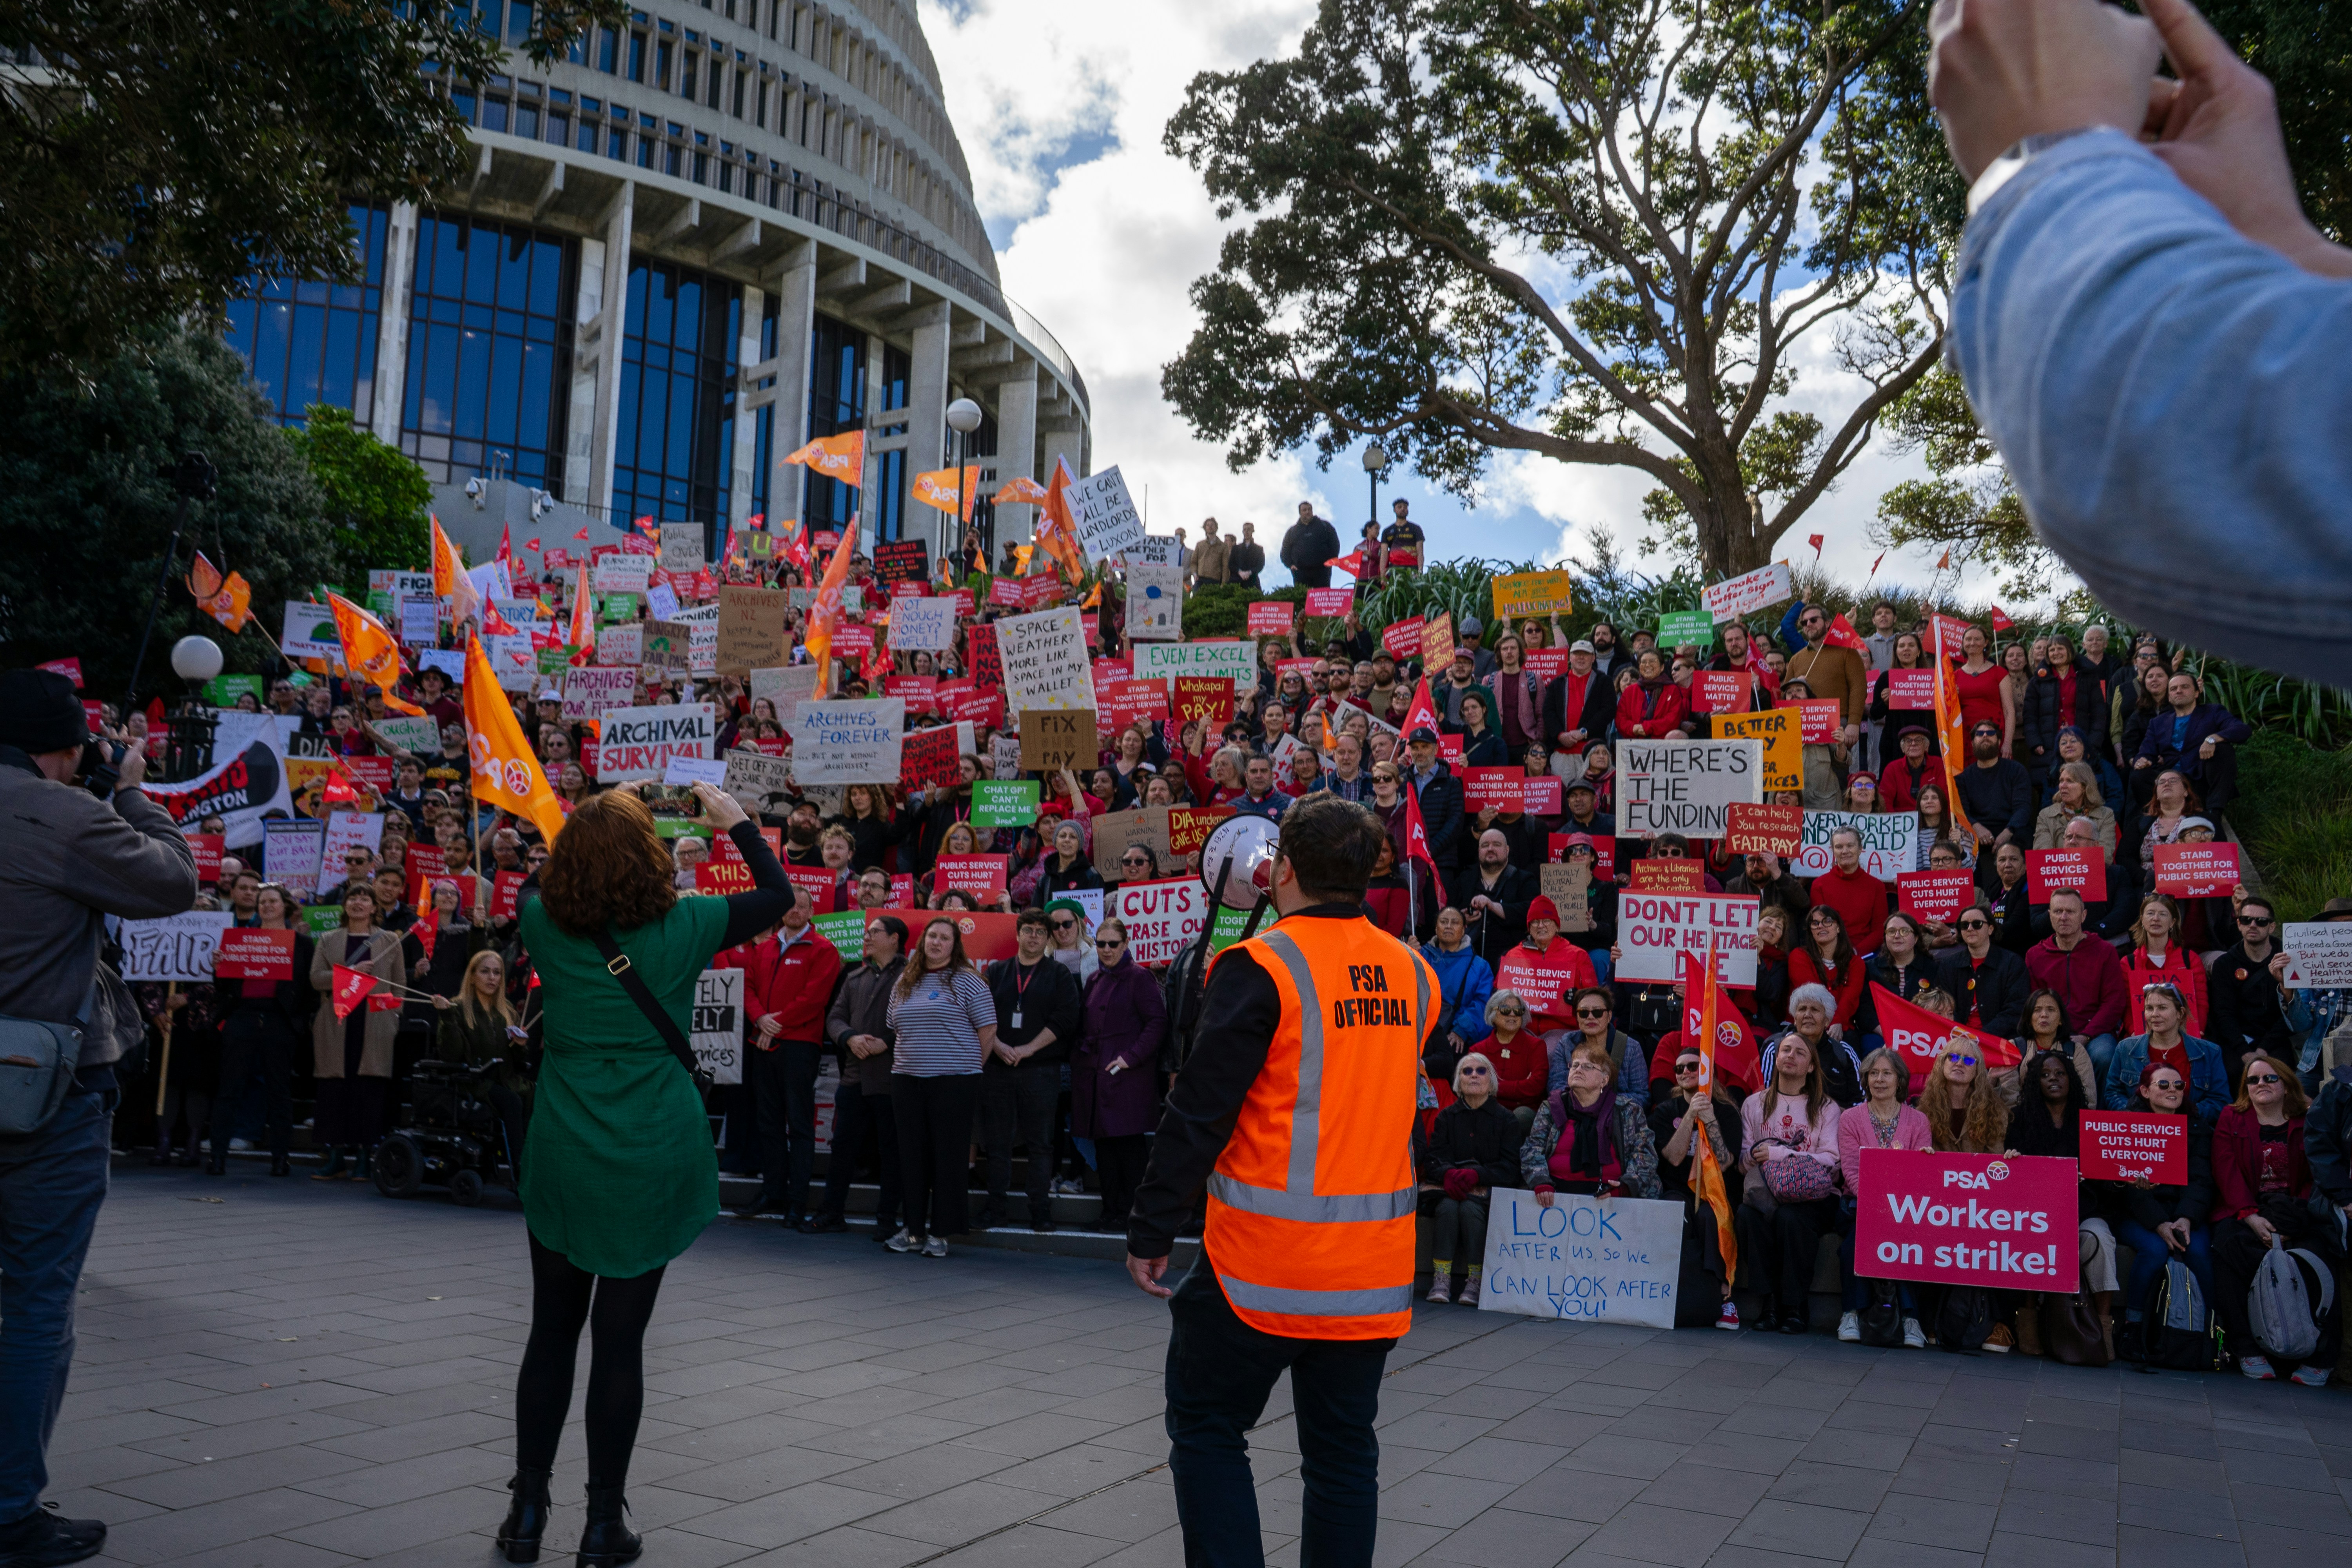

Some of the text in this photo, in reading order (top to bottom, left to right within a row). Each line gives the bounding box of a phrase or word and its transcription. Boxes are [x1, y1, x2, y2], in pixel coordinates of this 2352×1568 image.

[1069, 472, 1121, 507] WE CAN'T
[1082, 493, 1122, 524] ALL BE
[1080, 508, 1138, 541] LANDLORDS
[1098, 528, 1138, 552] LUXON
[1727, 574, 1760, 592] make
[1711, 580, 1774, 607] better sign
[894, 598, 921, 612] NOT
[1714, 603, 1731, 616] but
[892, 611, 943, 622] ENOUGH
[889, 622, 940, 634] MONEY?
[1015, 619, 1060, 639] SPACE
[889, 634, 938, 647] AWFUL!
[1006, 634, 1074, 656] WEATHER?
[1009, 649, 1069, 671] MORE LIKE
[1151, 647, 1247, 665] EVEN EXCEL
[566, 671, 635, 690] ARCHIVES
[1014, 662, 1083, 683] SPACE IN MY
[587, 690, 608, 699] ARE
[1027, 678, 1074, 696] WALLET
[1180, 680, 1225, 693] Whakapai
[1194, 695, 1207, 704] my
[564, 702, 587, 716] OUR
[1181, 700, 1224, 720] PAY!
[806, 711, 876, 728] ARCHIVES
[1724, 715, 1787, 737] BETTER
[604, 717, 711, 745] ARCHIVAL
[821, 729, 891, 745] FOREVER
[299, 736, 330, 757] DIA
[1043, 750, 1075, 766] PAY
[1629, 748, 1748, 773] WHERE'S
[984, 786, 1027, 794] CHAT GPT
[1630, 778, 1688, 800] THE
[991, 795, 1019, 804] CAN'T
[979, 804, 1016, 813] REPLACE
[1628, 804, 1729, 829] FUNDIN
[1733, 805, 1792, 820] I can help
[1172, 812, 1195, 829] DIA
[1758, 822, 1799, 833] research
[1803, 813, 1914, 833] VERWORKED
[1171, 829, 1192, 850] GIVE
[1731, 835, 1798, 854] FAIR PAY
[2045, 853, 2081, 863] PUBLIC
[2180, 851, 2213, 859] STAND
[969, 862, 1003, 870] SERVICE
[1670, 862, 1699, 873] Libraries
[2040, 864, 2089, 875] SERVICES
[2162, 861, 2232, 870] TOGETHER FOR
[1657, 874, 1670, 882] the
[1673, 874, 1689, 885] only
[1901, 878, 1969, 888] PUBLIC SERVICE
[2044, 877, 2085, 887] MATTER
[2158, 871, 2238, 880] PUBLIC SERVICES
[1936, 888, 1960, 897] HURT
[1124, 886, 1191, 916] CUTS
[1914, 899, 1959, 908] EVERYONE
[1710, 902, 1758, 927] LET
[242, 935, 271, 944] STAND
[1631, 925, 1675, 946] OUR
[2285, 926, 2328, 938] Civilised
[130, 928, 215, 977] FAIR
[225, 944, 267, 953] TOGETHER
[2284, 941, 2302, 950] dont
[2304, 940, 2324, 948] need
[220, 953, 291, 964] PUBLIC SERVICES
[2297, 950, 2318, 960] But
[1504, 965, 1571, 978] PUBLIC SERVICE
[2303, 960, 2324, 969] Civil
[1348, 965, 1388, 993] PSA
[1512, 977, 1535, 985] CUTS
[2310, 969, 2343, 977] Health
[1513, 988, 1557, 999] EVERYONE
[1335, 998, 1412, 1029] OFFICIAL
[1892, 1029, 1947, 1058] PSA
[2085, 1122, 2181, 1135] PUBLIC SERVICE
[2099, 1137, 2167, 1148] CUTS HURT
[2102, 1149, 2165, 1161] EVERYONE
[1944, 1171, 1990, 1190] PSA
[1513, 1201, 1622, 1240] LOOK
[1887, 1194, 2049, 1232] Workers
[1499, 1243, 1560, 1261] AFTER
[1877, 1241, 2056, 1275] on strike!
[1491, 1267, 1670, 1298] CAN LOOK AFTER
[1549, 1297, 1606, 1318] YOU!
